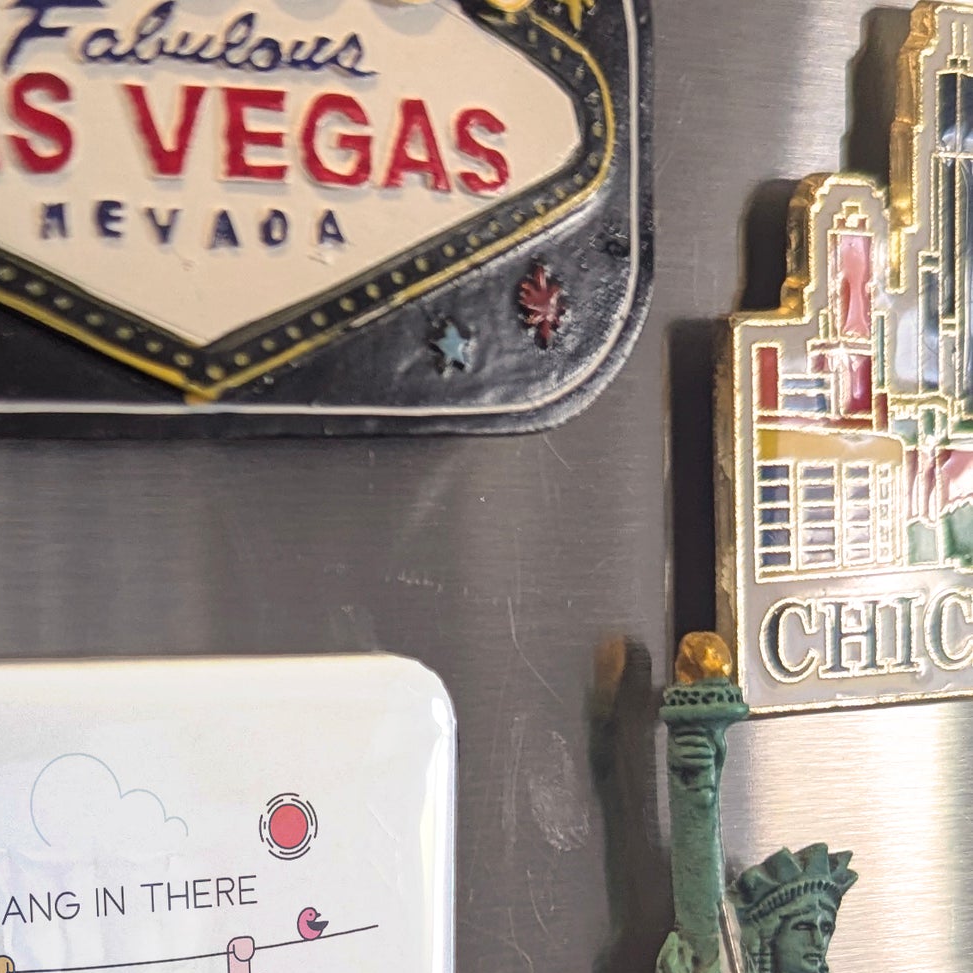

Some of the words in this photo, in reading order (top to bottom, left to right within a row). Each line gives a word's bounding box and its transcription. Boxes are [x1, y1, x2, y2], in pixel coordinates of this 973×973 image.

[3, 0, 377, 76] Fabulous
[124, 83, 510, 195] VEGAS
[759, 587, 973, 683] CHIC
[95, 885, 125, 917] IN
[140, 875, 258, 913] THERE
